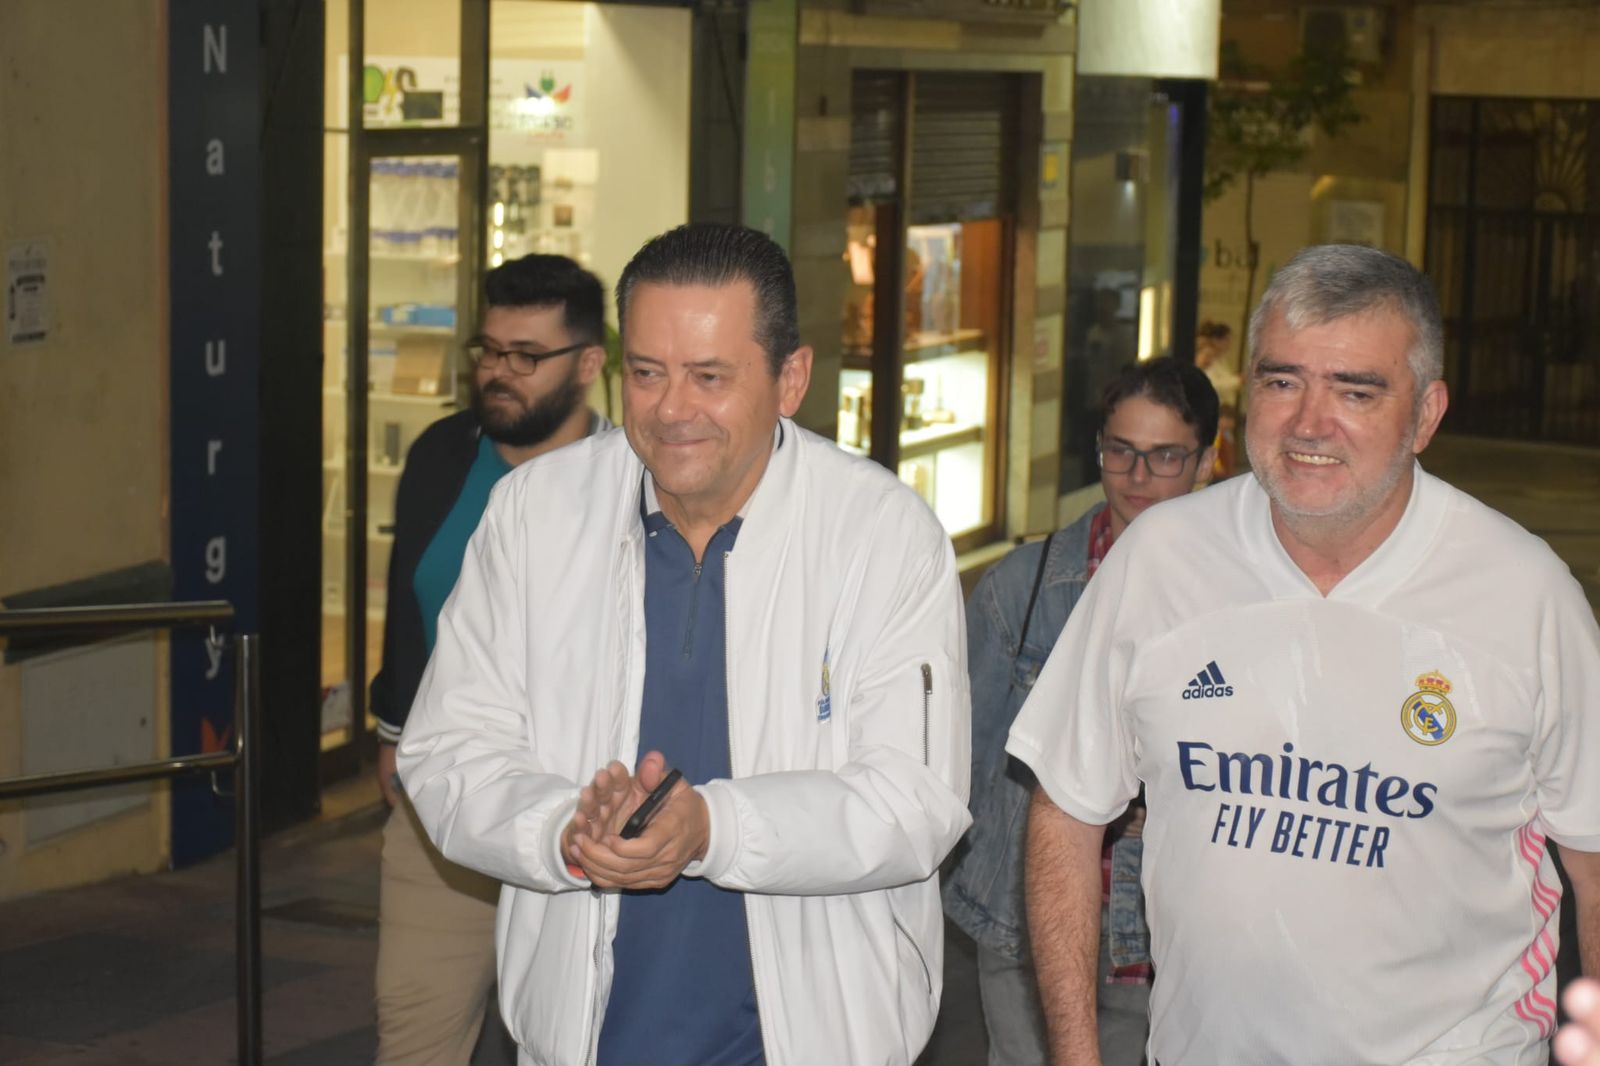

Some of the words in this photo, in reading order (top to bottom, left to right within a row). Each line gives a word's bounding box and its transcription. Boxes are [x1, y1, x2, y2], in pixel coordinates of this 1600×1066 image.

[203, 24, 227, 680] Naturgy
[1182, 684, 1233, 700] adidas
[1176, 741, 1438, 819] Emirates
[1211, 802, 1267, 849] FLY
[1270, 810, 1391, 868] BETTER
